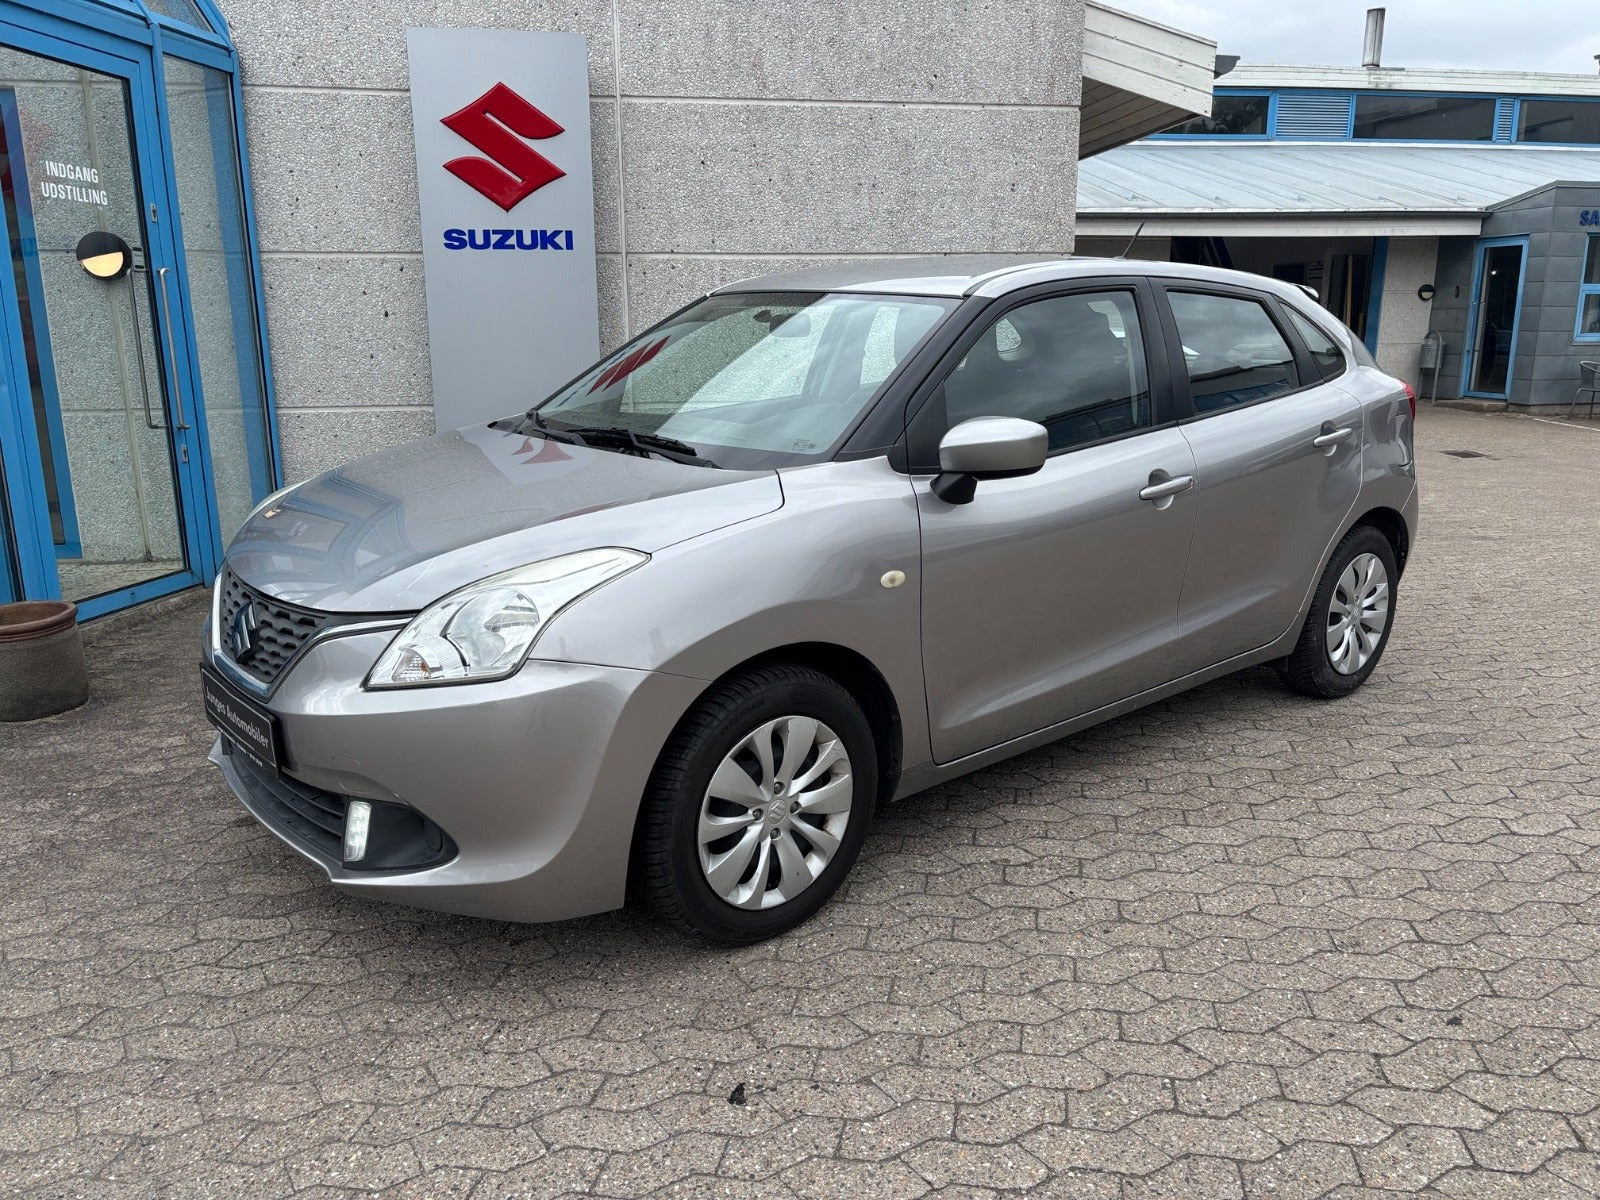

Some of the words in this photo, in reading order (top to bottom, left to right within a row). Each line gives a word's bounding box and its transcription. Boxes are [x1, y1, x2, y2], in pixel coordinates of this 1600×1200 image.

[45, 161, 99, 183] INDGANG
[41, 182, 108, 205] UDSTILLING
[443, 229, 574, 250] SUZUKI
